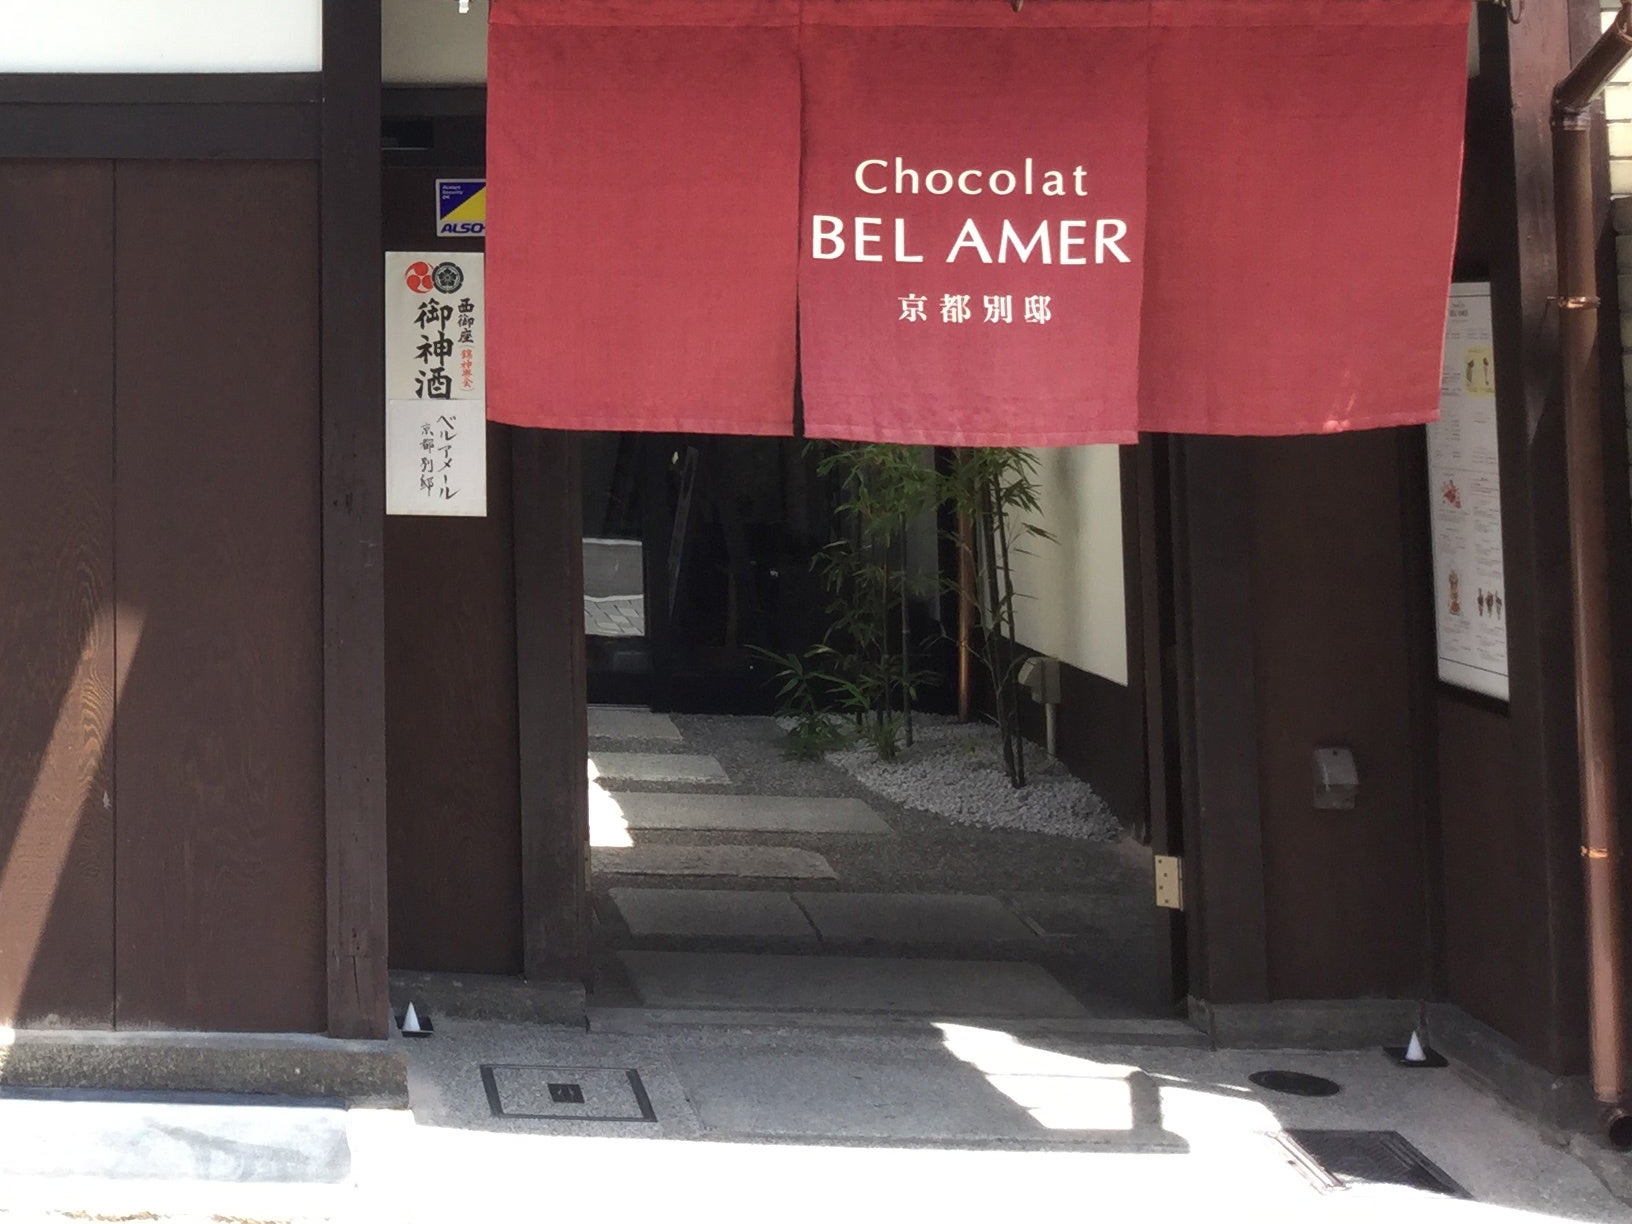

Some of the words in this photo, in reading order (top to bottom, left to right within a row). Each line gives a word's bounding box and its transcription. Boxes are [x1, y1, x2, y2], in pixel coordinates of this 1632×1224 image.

[854, 156, 1088, 196] Chocolat
[440, 222, 486, 234] ALSO
[812, 214, 924, 263] BEL
[945, 217, 1131, 265] AMER
[457, 297, 475, 344] 西御座
[898, 293, 1052, 324] 京都別邸
[414, 297, 454, 400] 御神酒
[419, 422, 435, 497] 京都別邸
[436, 415, 461, 500] ベルアメール
